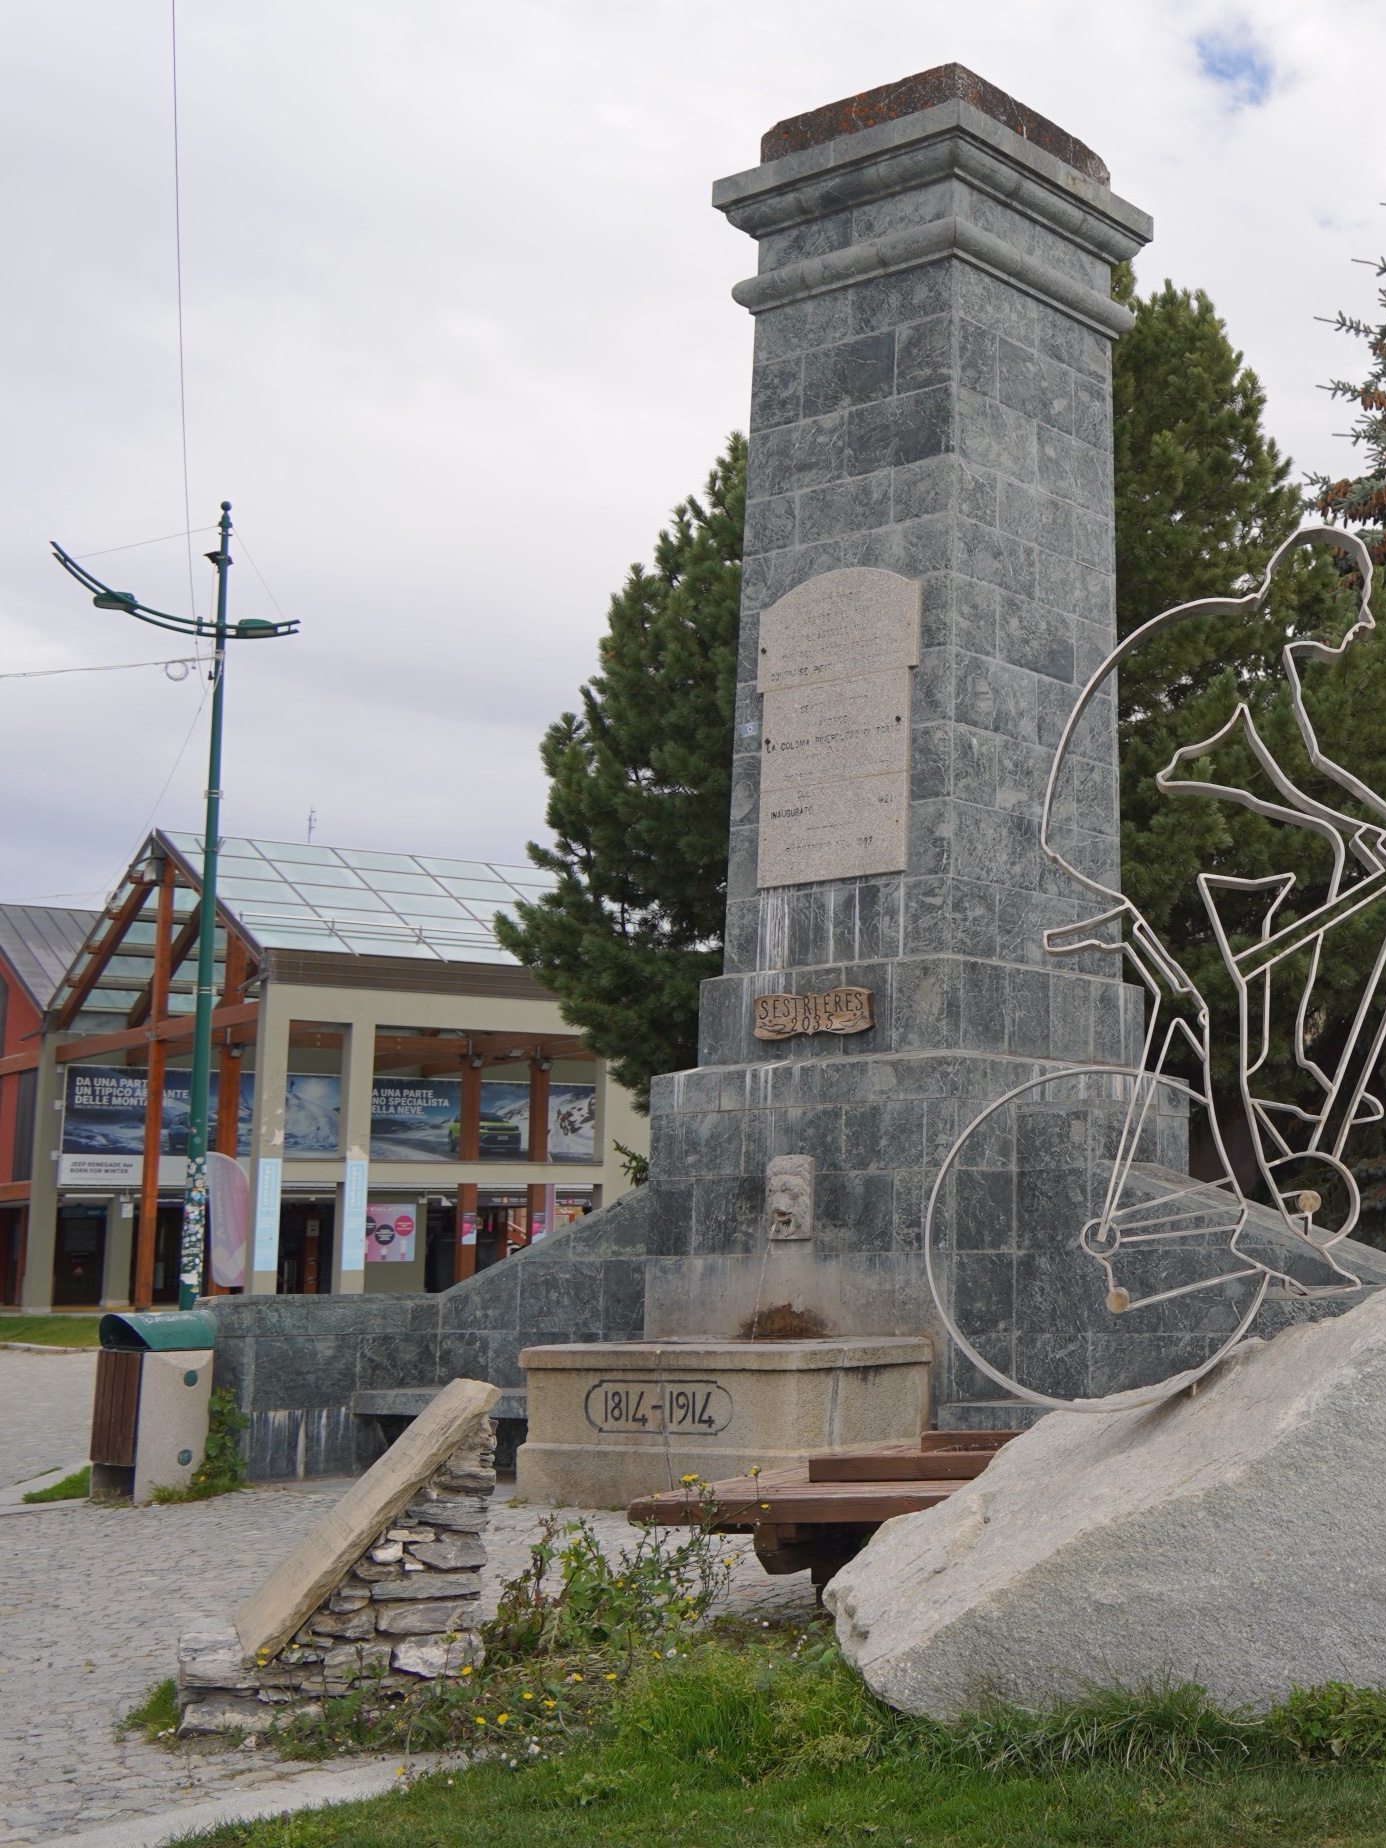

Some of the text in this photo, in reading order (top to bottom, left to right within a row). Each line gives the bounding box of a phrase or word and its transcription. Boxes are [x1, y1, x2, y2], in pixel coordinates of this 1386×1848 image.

[791, 1014, 834, 1031] 2035
[76, 1077, 149, 1088] DA UNA PART
[76, 1087, 91, 1095] UN
[94, 1087, 132, 1096] TIPICO
[381, 1089, 401, 1097] UNA
[403, 1090, 434, 1098] PARTE
[75, 1096, 109, 1105] DELLE
[388, 1098, 449, 1107] SPECIALISTA
[398, 1106, 425, 1114] NEVE.
